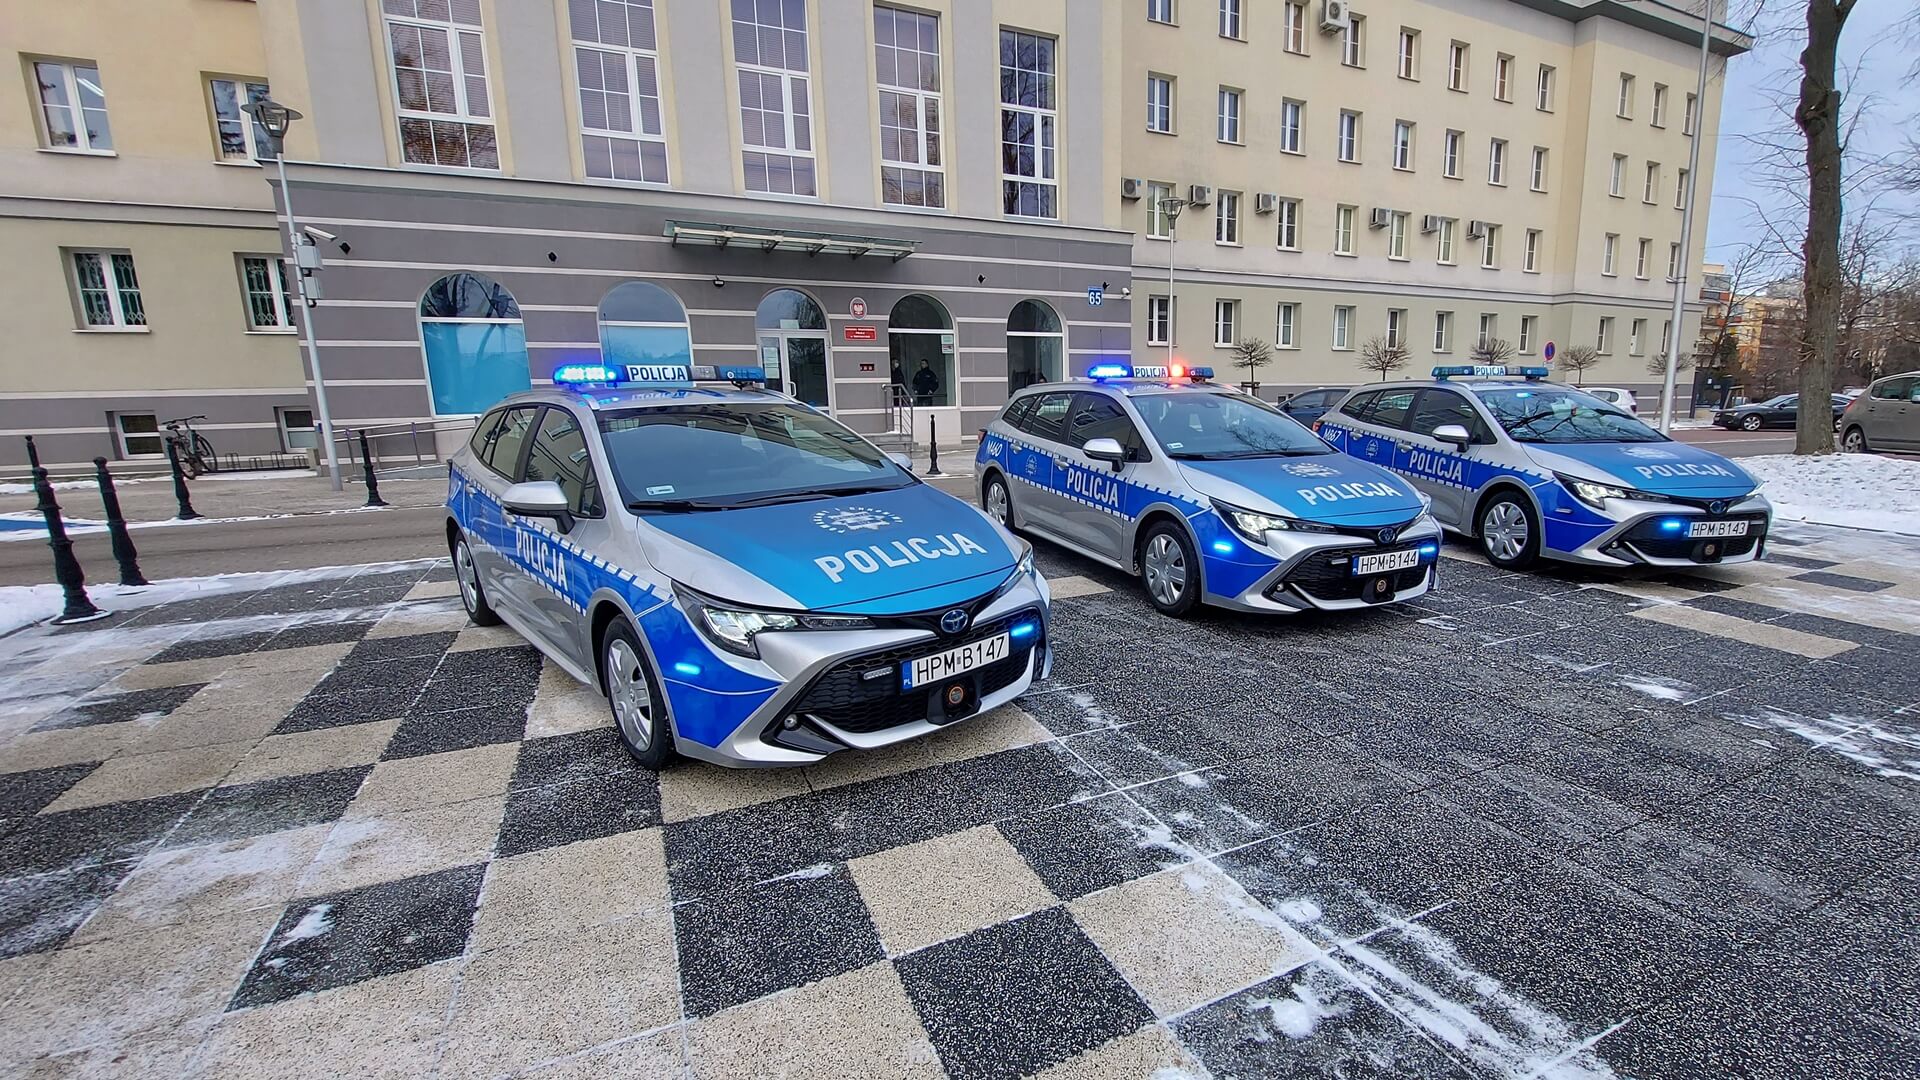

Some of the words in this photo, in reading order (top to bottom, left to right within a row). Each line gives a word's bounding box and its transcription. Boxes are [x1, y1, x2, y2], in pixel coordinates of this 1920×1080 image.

[1090, 292, 1101, 305] 65
[629, 367, 686, 380] POLICJA
[1135, 367, 1167, 378] POLICJA
[1475, 366, 1505, 376] POLICJA
[1409, 450, 1463, 482] POLICJA
[1634, 463, 1736, 479] POLICJA
[1066, 467, 1119, 508] POLICJA
[1297, 482, 1402, 505] POLICJA
[1691, 523, 1715, 536] HPM
[1718, 522, 1746, 536] B143
[516, 526, 569, 591] POLICJA
[814, 533, 988, 583] POLICJA
[1361, 555, 1386, 572] HPM
[1389, 551, 1417, 569] B144
[917, 653, 956, 684] HPM
[962, 636, 1005, 669] B147
